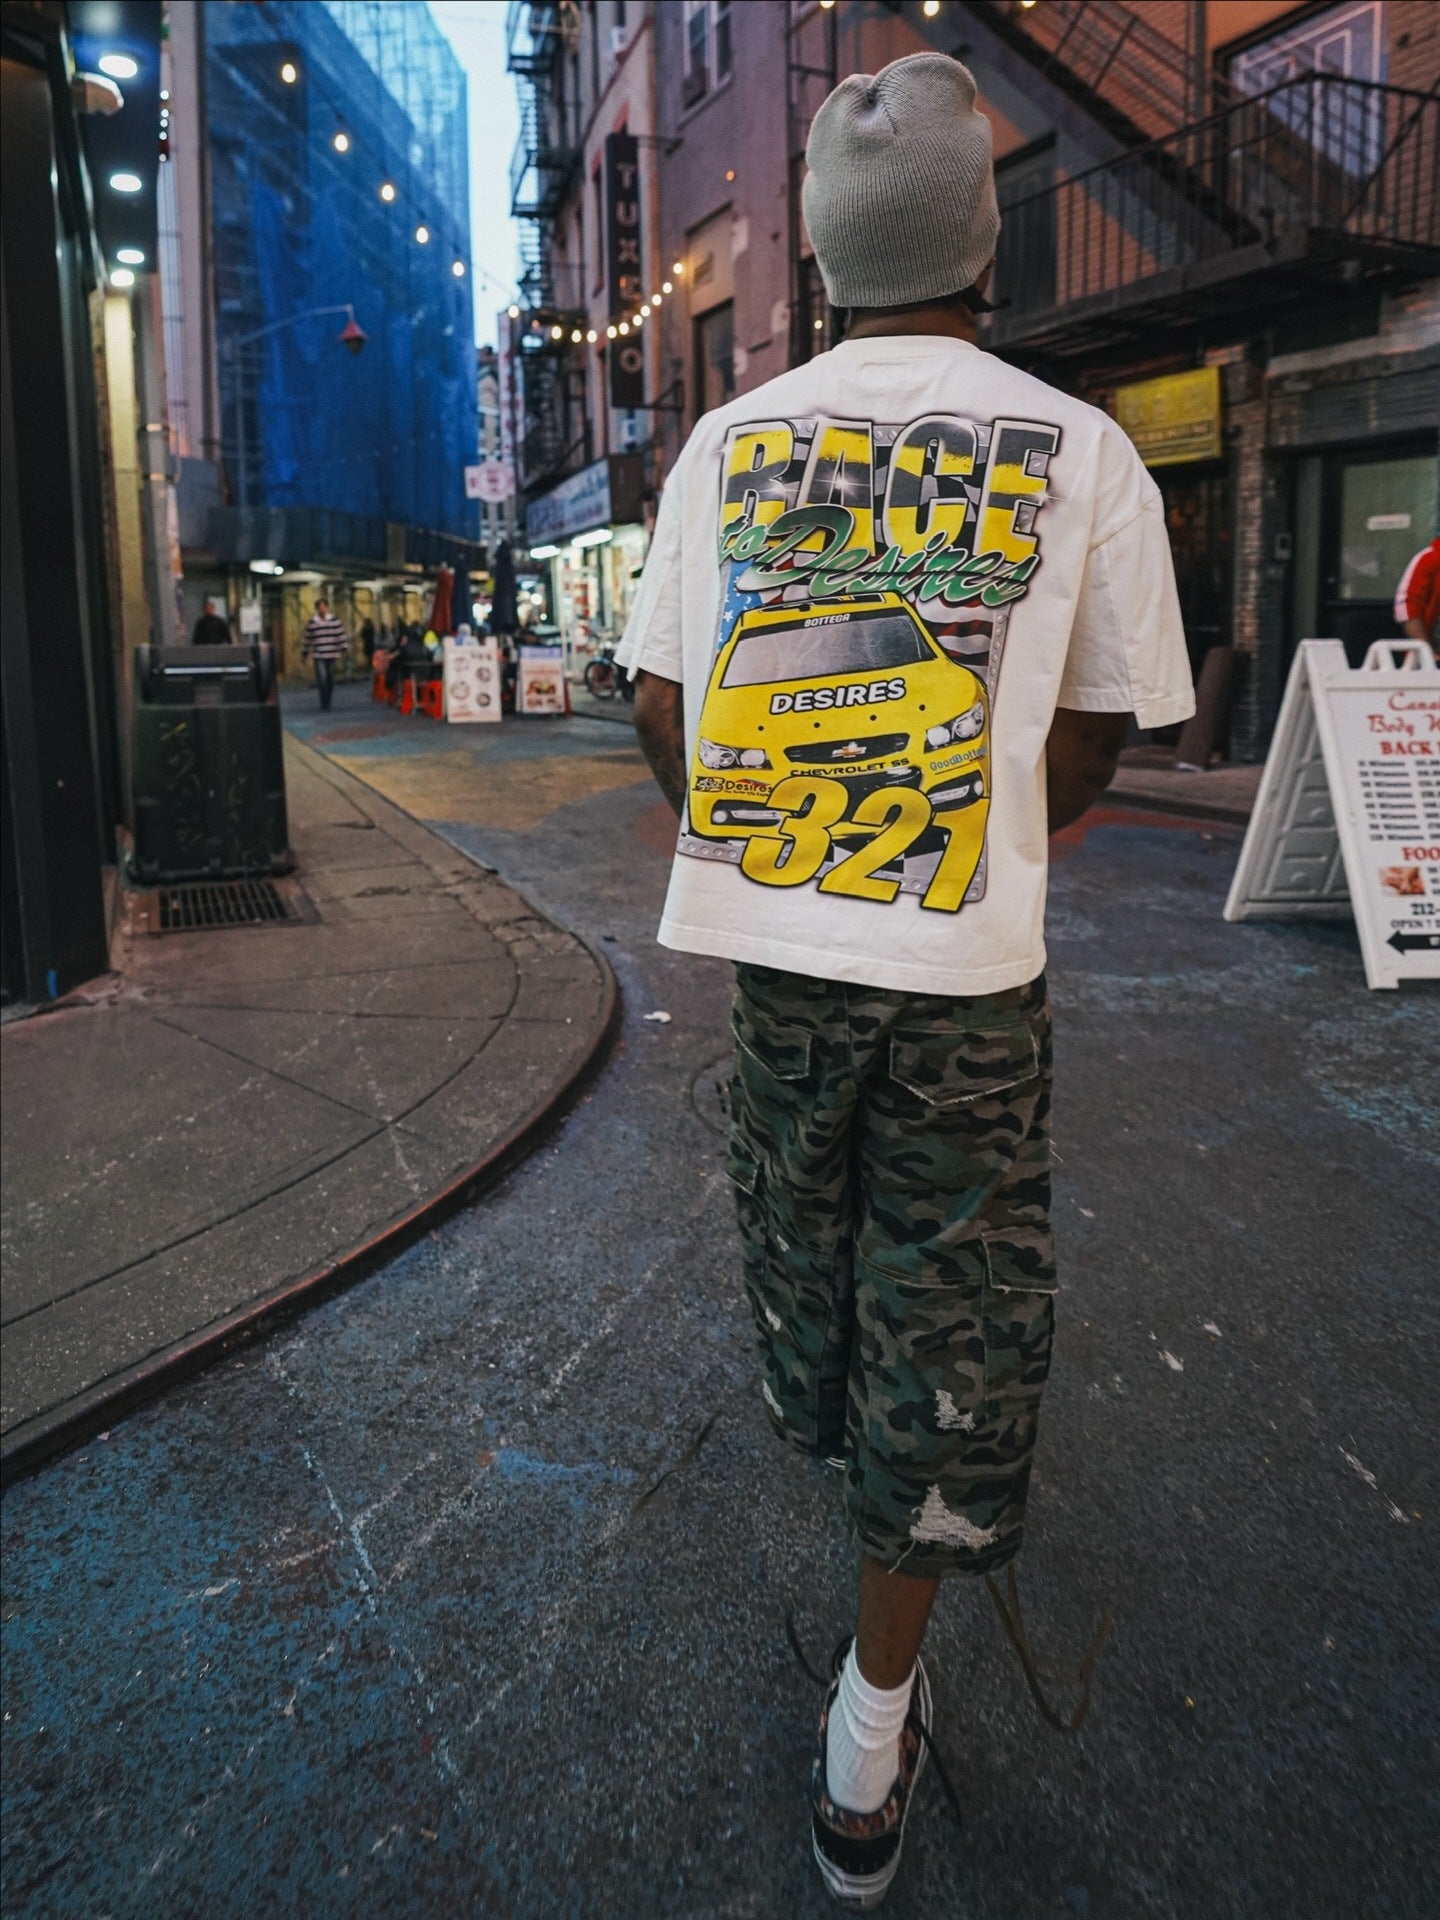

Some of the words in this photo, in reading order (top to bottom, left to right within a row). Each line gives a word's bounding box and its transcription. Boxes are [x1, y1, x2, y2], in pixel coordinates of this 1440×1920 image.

[720, 413, 1061, 564] RACE
[719, 513, 769, 566] to
[736, 503, 1040, 607] Desires
[804, 613, 850, 628] BOTTEGA
[769, 677, 906, 715] DESIRES
[1388, 690, 1440, 711] Cana
[790, 762, 886, 776] CHEVROLET
[891, 757, 910, 768] SS
[1380, 741, 1433, 755] BACK
[740, 775, 992, 912] 321
